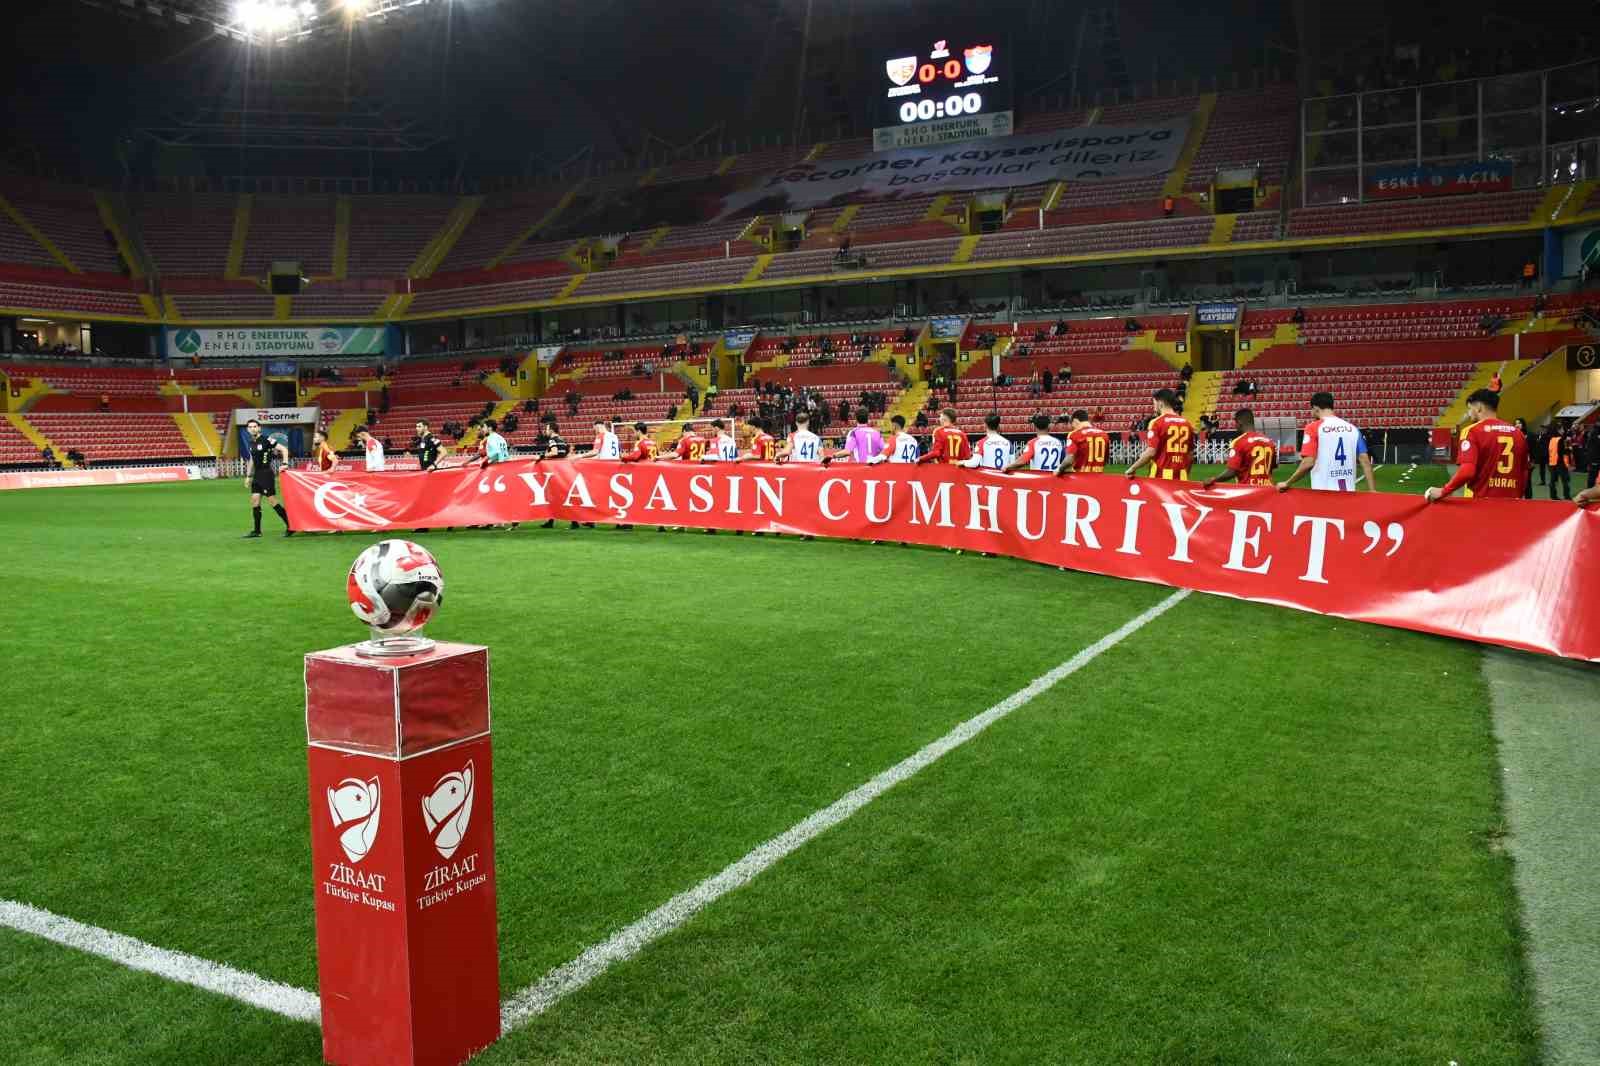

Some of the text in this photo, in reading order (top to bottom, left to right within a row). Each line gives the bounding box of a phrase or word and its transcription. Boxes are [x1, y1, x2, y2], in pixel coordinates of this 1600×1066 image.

[900, 93, 982, 122] 00:00
[255, 341, 315, 350] STADYUMU
[611, 440, 617, 457] 5
[800, 442, 815, 459] 41
[902, 444, 916, 462] 42
[947, 435, 962, 457] 17
[1086, 436, 1105, 462] 10
[1167, 425, 1189, 453] 22
[1335, 436, 1347, 466] 4
[994, 448, 1003, 468] 8
[1040, 447, 1059, 469] 22
[1250, 446, 1272, 475] 20
[1497, 436, 1514, 474] 3
[330, 862, 386, 893] ZİRAAT
[424, 853, 479, 892] ZİRAAT
[323, 881, 396, 912] Türkiye Kupası
[416, 873, 487, 910] Türkiye Kupası
